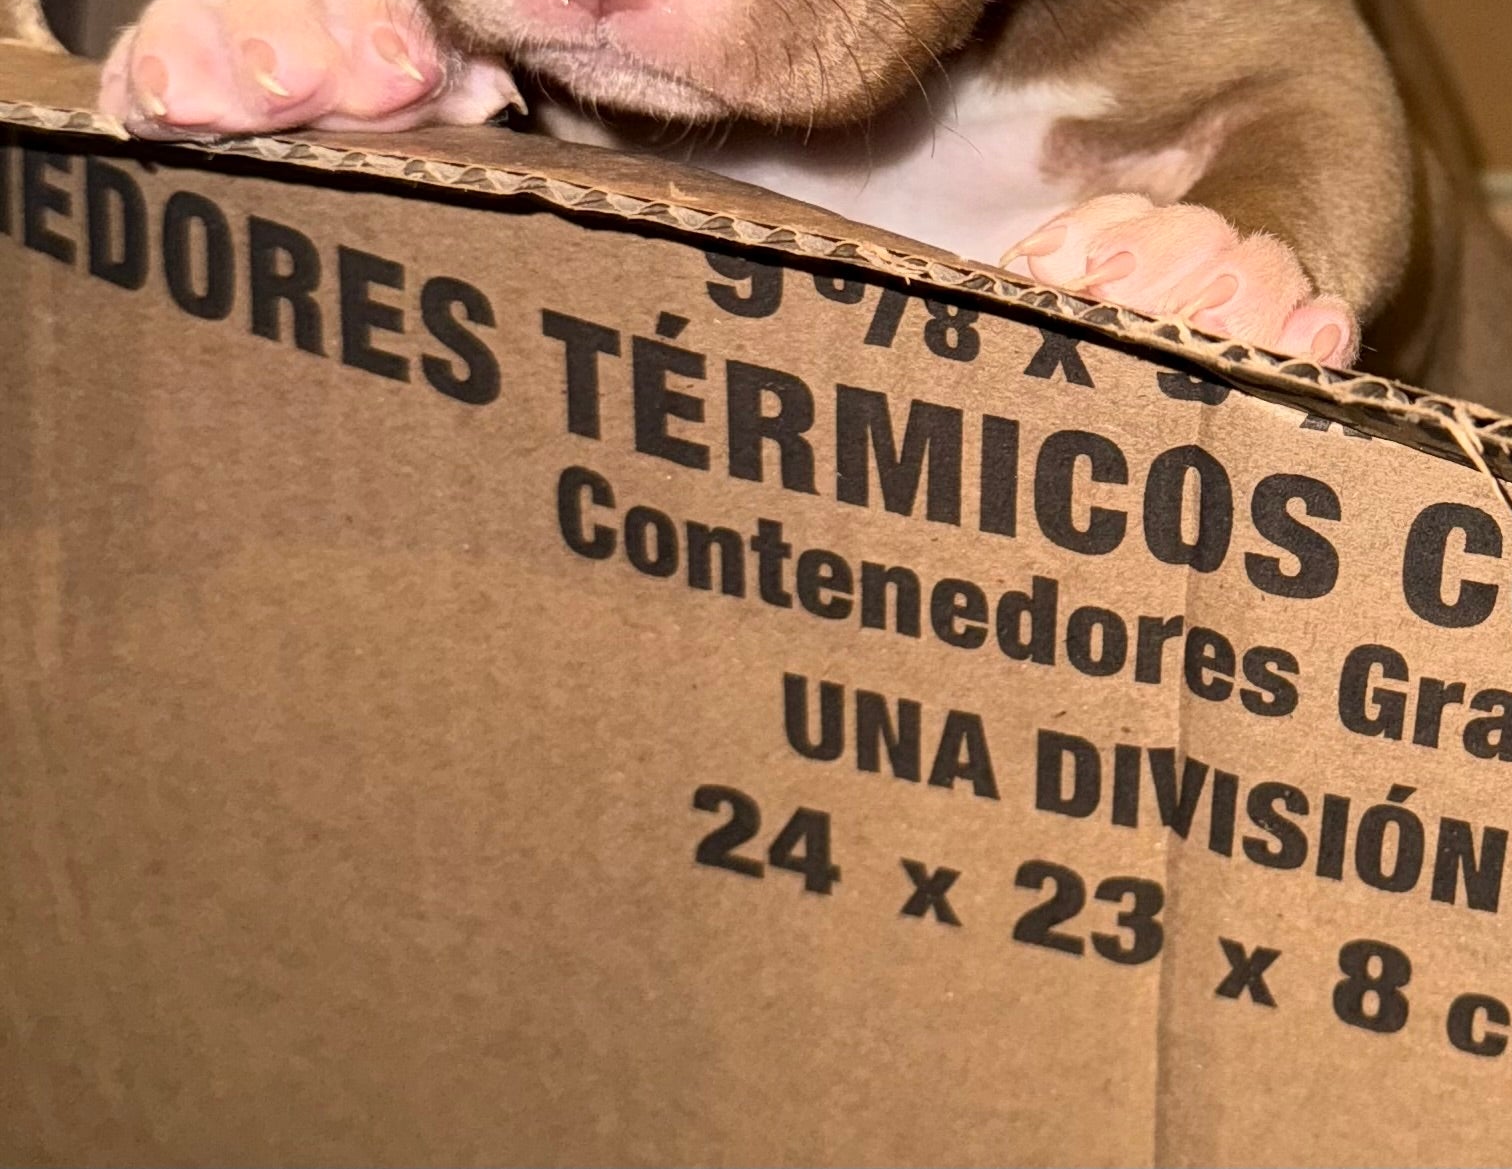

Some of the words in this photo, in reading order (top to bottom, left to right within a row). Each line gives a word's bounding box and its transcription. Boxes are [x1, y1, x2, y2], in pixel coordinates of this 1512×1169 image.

[0, 140, 501, 406] EDORES
[541, 310, 1342, 600] TÉRMICOS
[557, 464, 1300, 718] Contenedores
[691, 783, 841, 895] 24
[898, 856, 963, 928] x
[1011, 858, 1166, 966] 23
[1213, 935, 1281, 1008] x
[1330, 938, 1411, 1034] 8
[782, 671, 1001, 801] UNA
[1035, 726, 1509, 914] DIVISIÓN
